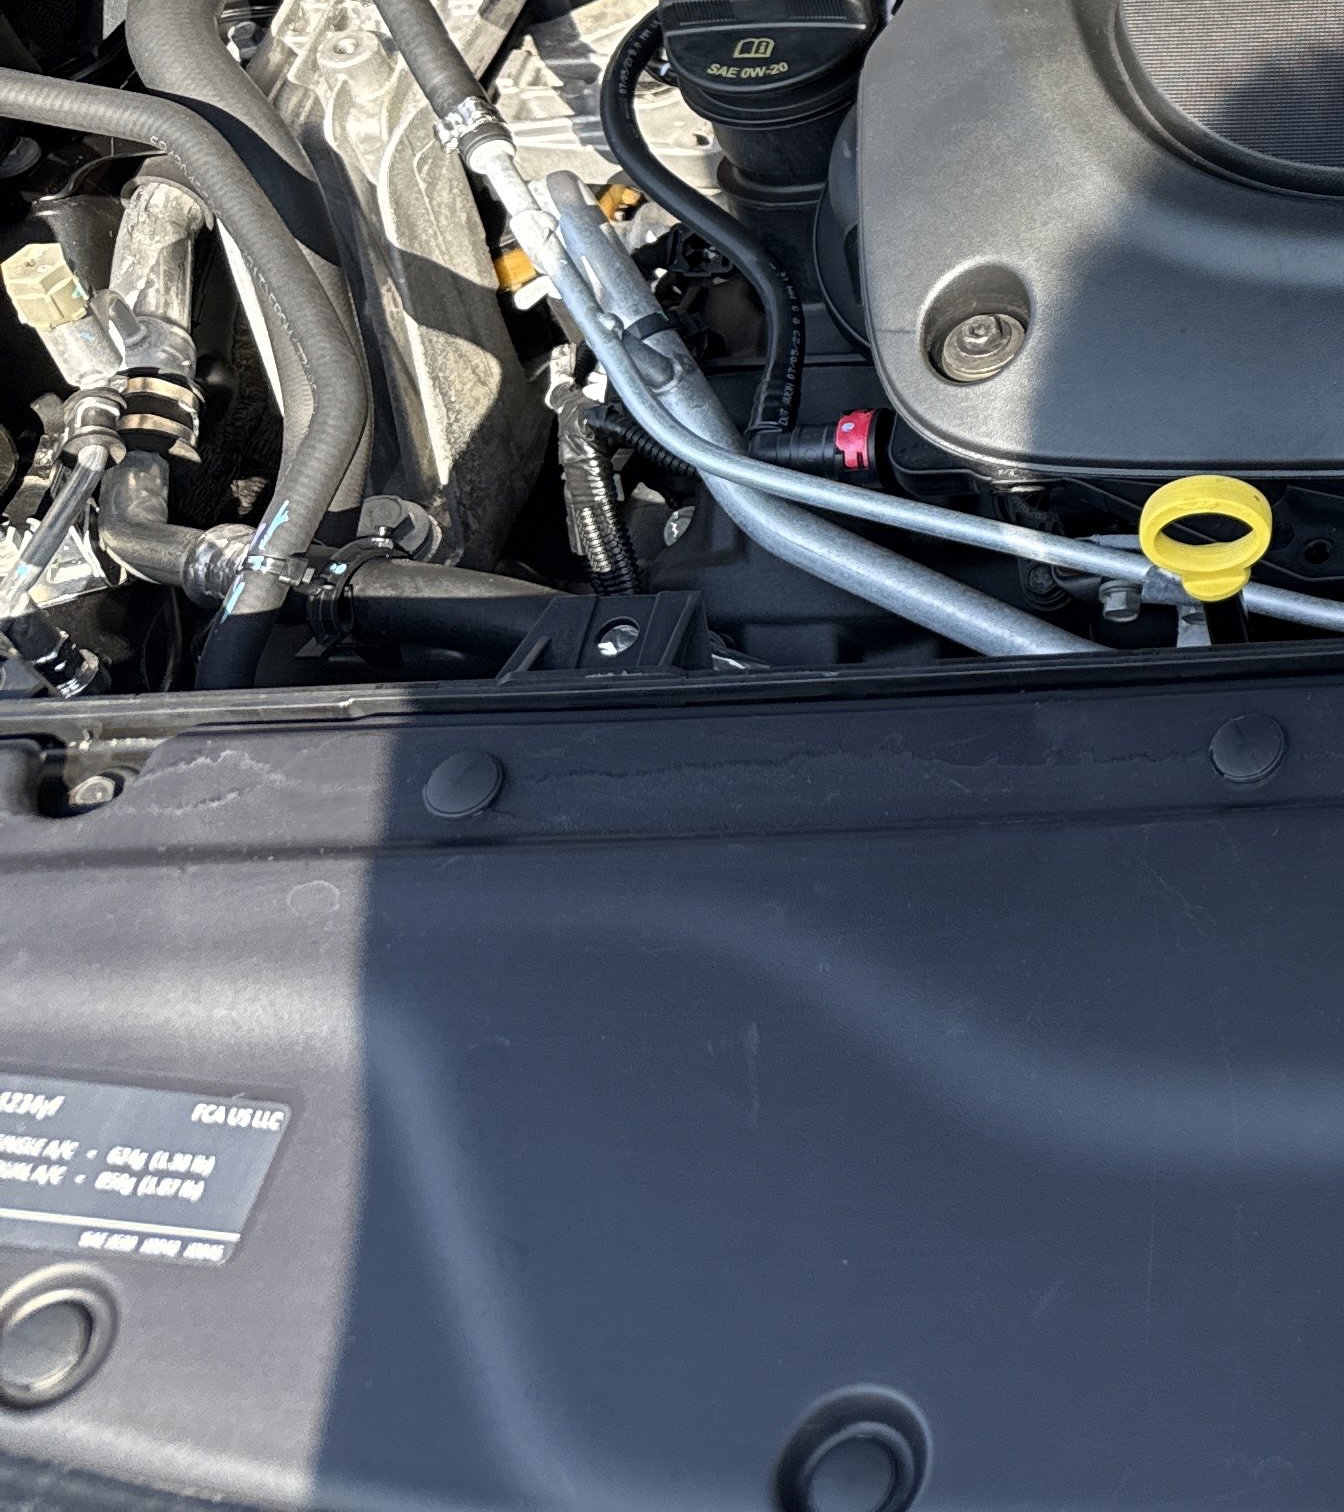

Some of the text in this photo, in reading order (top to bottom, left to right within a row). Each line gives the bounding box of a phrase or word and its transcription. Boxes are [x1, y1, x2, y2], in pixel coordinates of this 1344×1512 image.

[706, 61, 789, 79] SAE 0W-20
[191, 1103, 284, 1131] FCA US LLC
